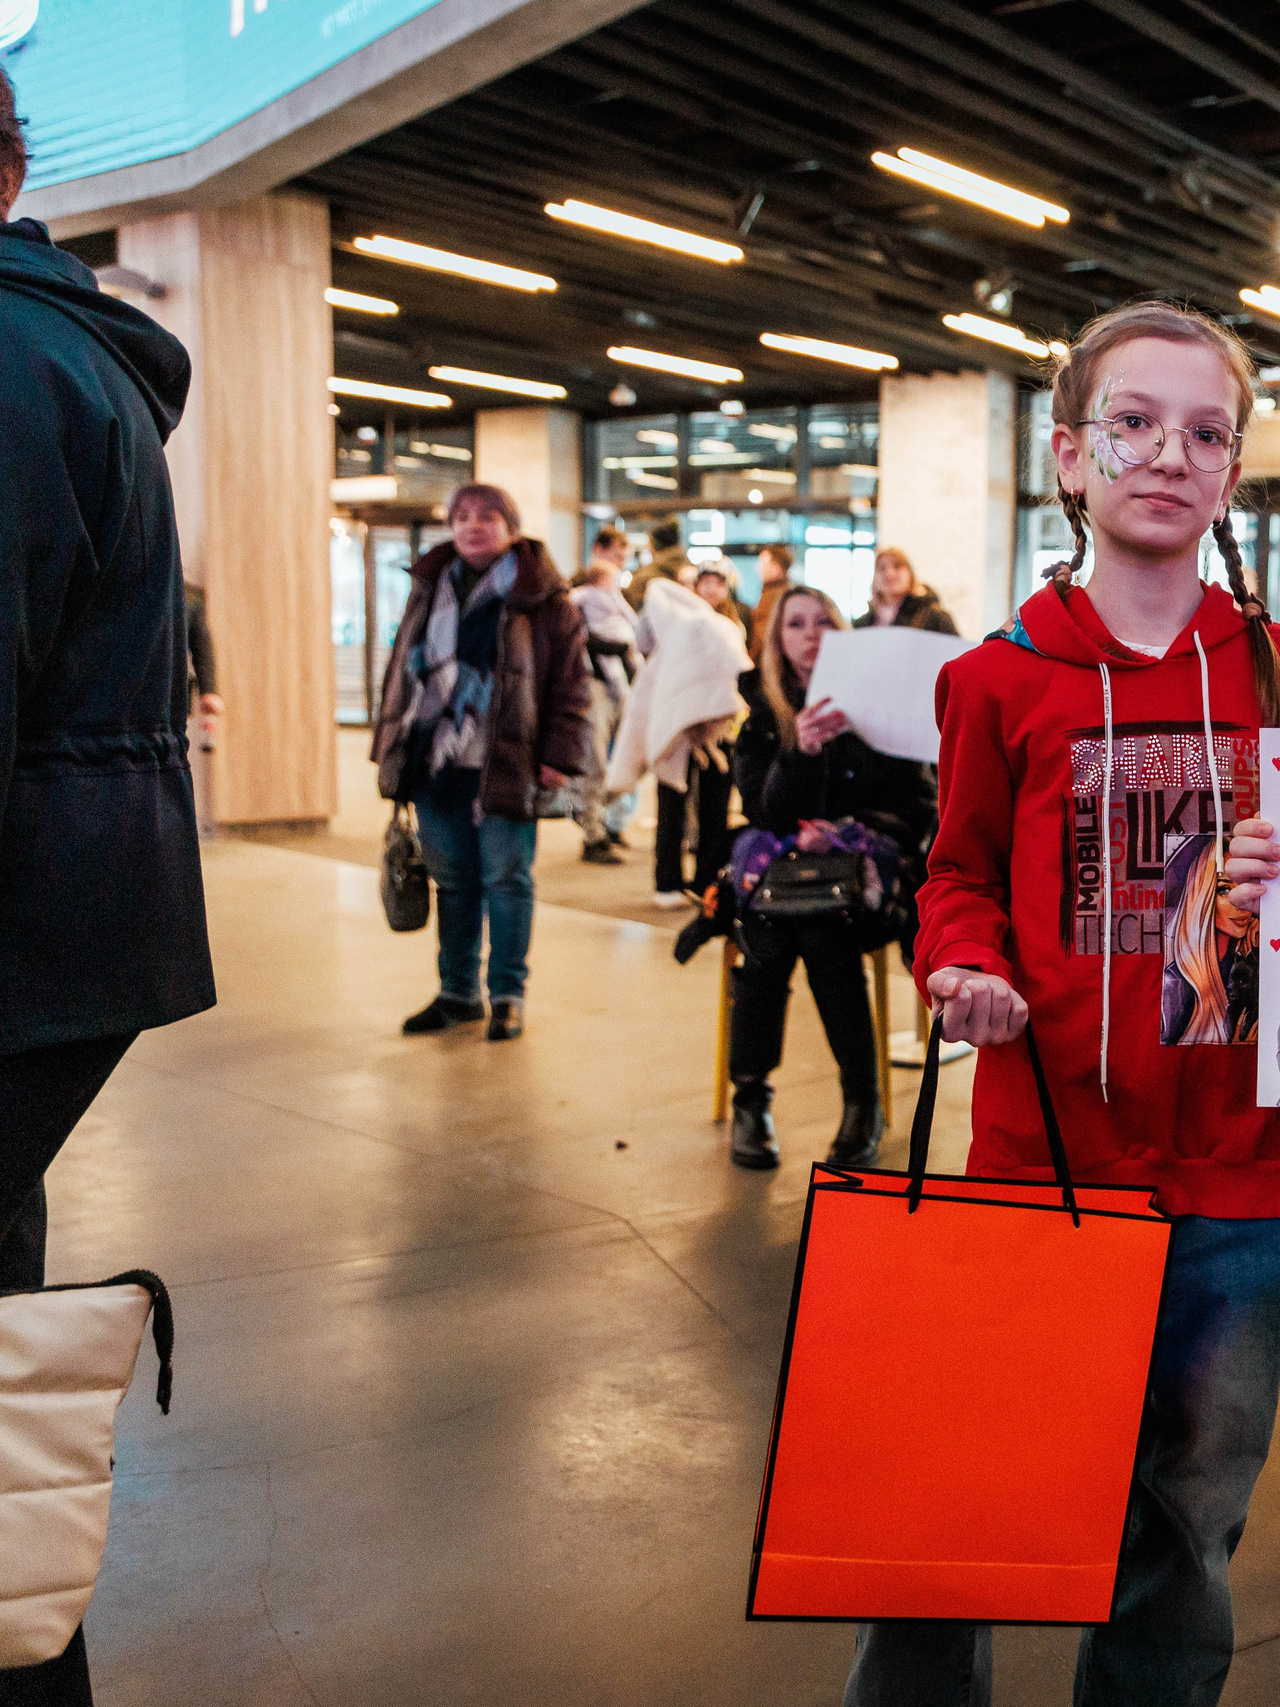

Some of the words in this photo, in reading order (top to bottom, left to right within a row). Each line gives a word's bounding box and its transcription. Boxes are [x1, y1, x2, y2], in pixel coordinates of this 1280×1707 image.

[1071, 734, 1233, 793] SHARE
[1075, 795, 1100, 911] MOBILE
[1097, 795, 1127, 888] POST
[1101, 882, 1165, 911] nlin
[1076, 913, 1164, 956] TECH
